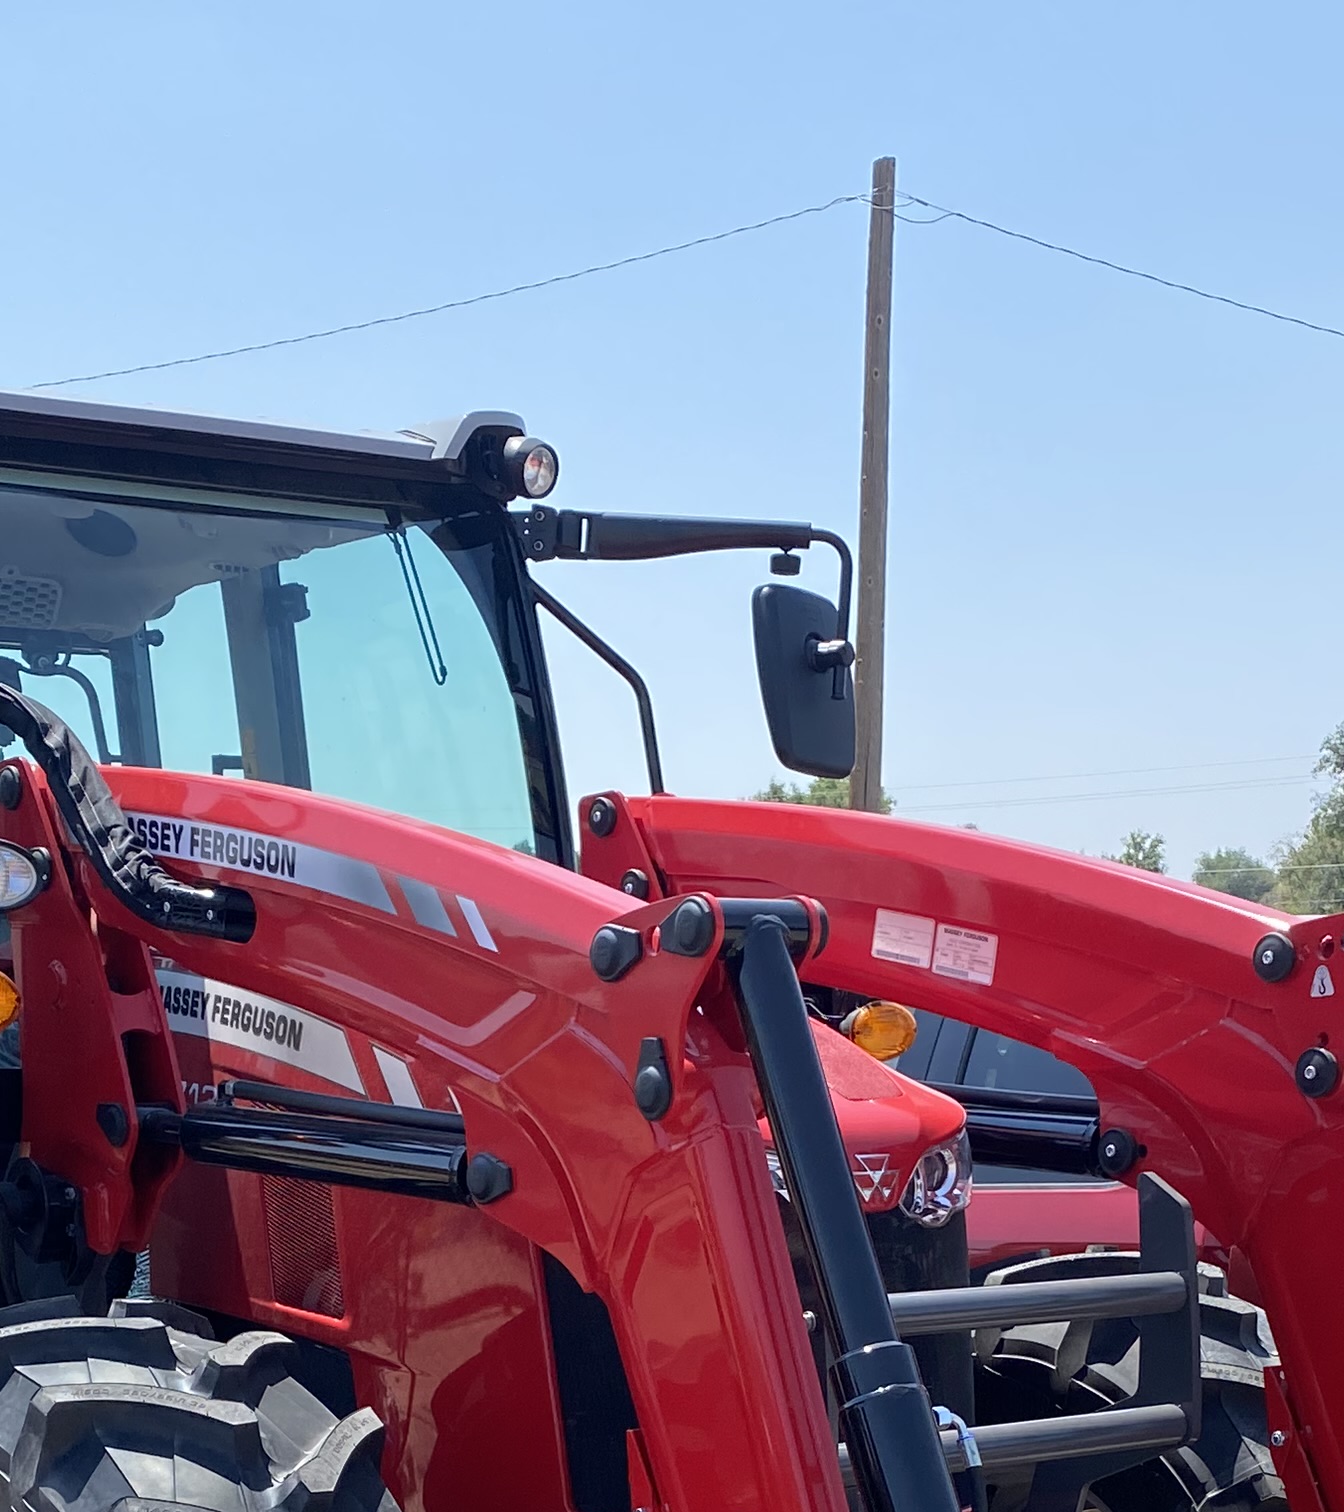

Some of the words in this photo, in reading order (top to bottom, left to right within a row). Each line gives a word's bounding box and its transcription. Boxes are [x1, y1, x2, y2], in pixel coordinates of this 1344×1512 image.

[128, 817, 184, 854] ASSEY
[190, 826, 297, 879] FERGUSON
[160, 985, 210, 1020] ASSEY
[211, 994, 303, 1051] FERGUSON
